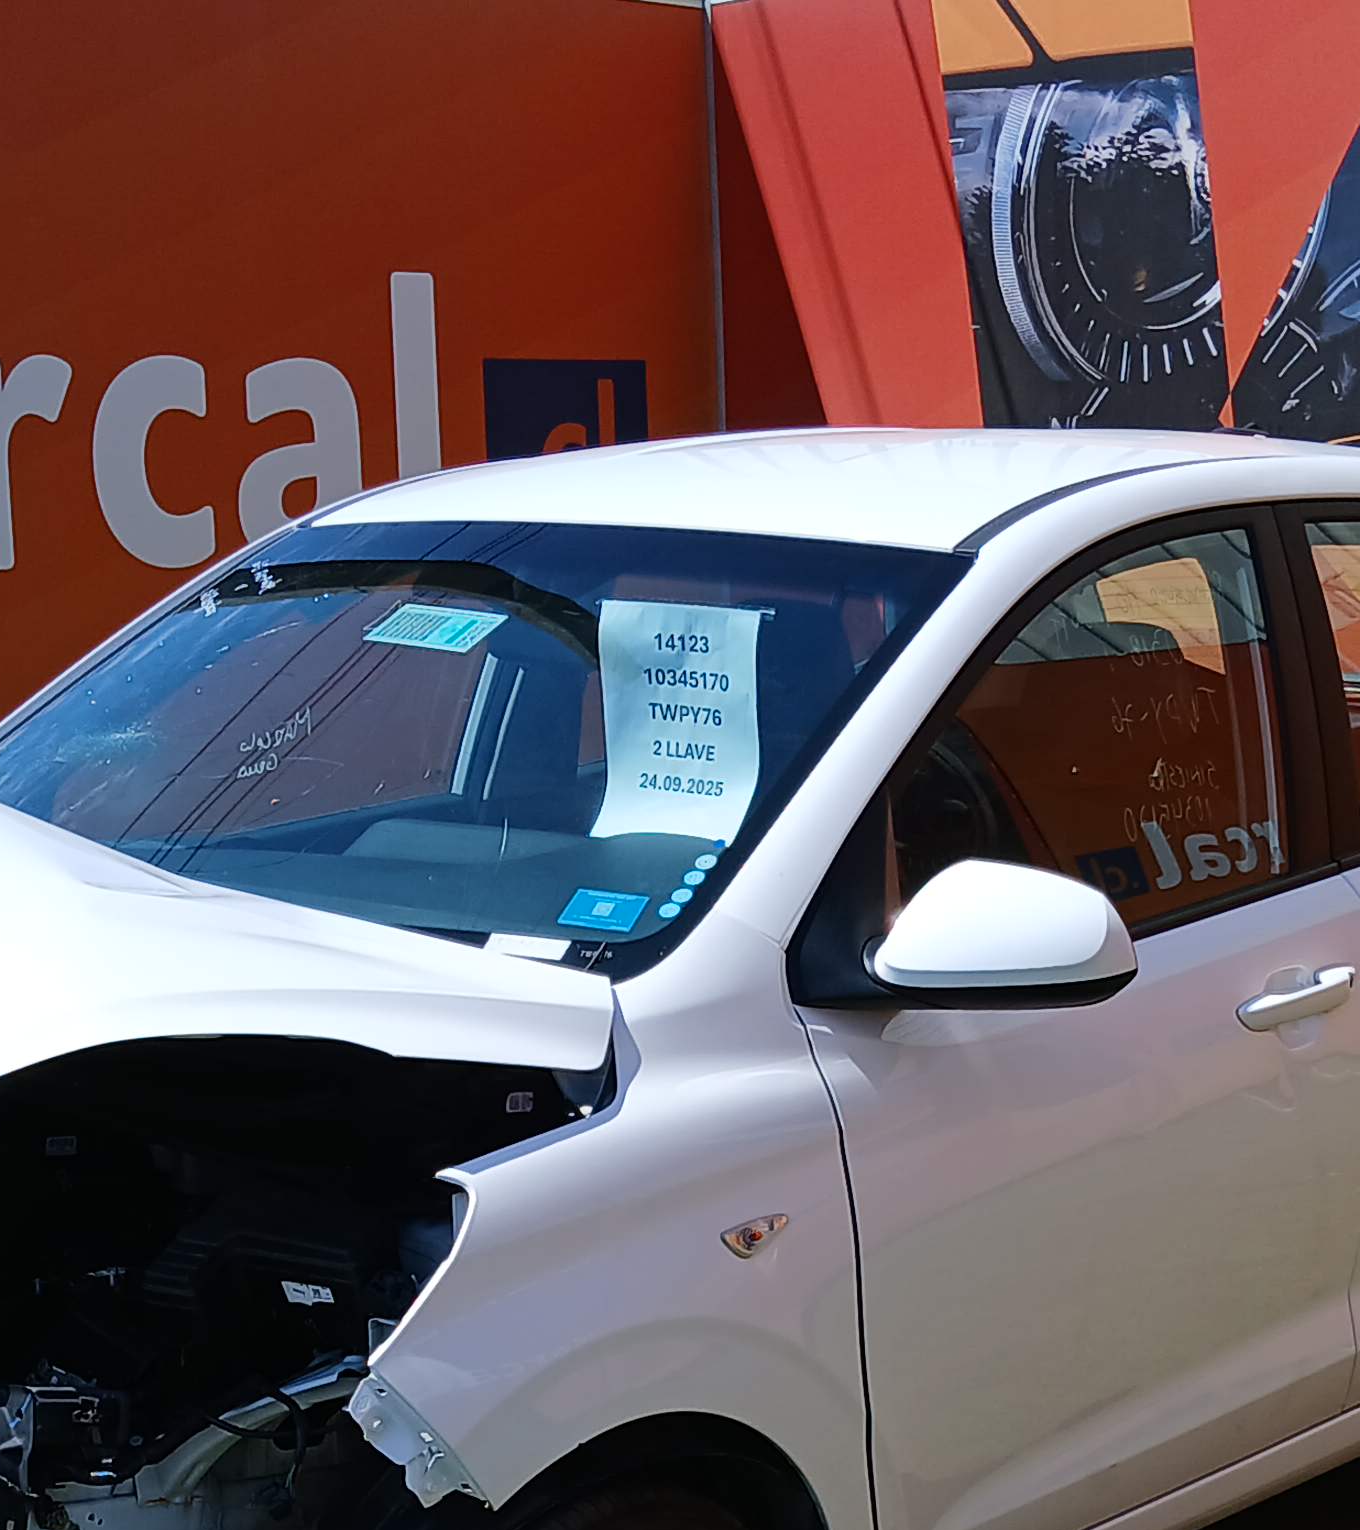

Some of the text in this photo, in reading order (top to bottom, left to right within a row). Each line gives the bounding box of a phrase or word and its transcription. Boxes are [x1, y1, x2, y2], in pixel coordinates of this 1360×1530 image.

[654, 633, 709, 653] 14123
[644, 668, 729, 692] 10345170
[648, 702, 722, 726] TWPY76
[653, 740, 715, 762] 2 LLAVE
[640, 773, 724, 797] 24.09.2025
